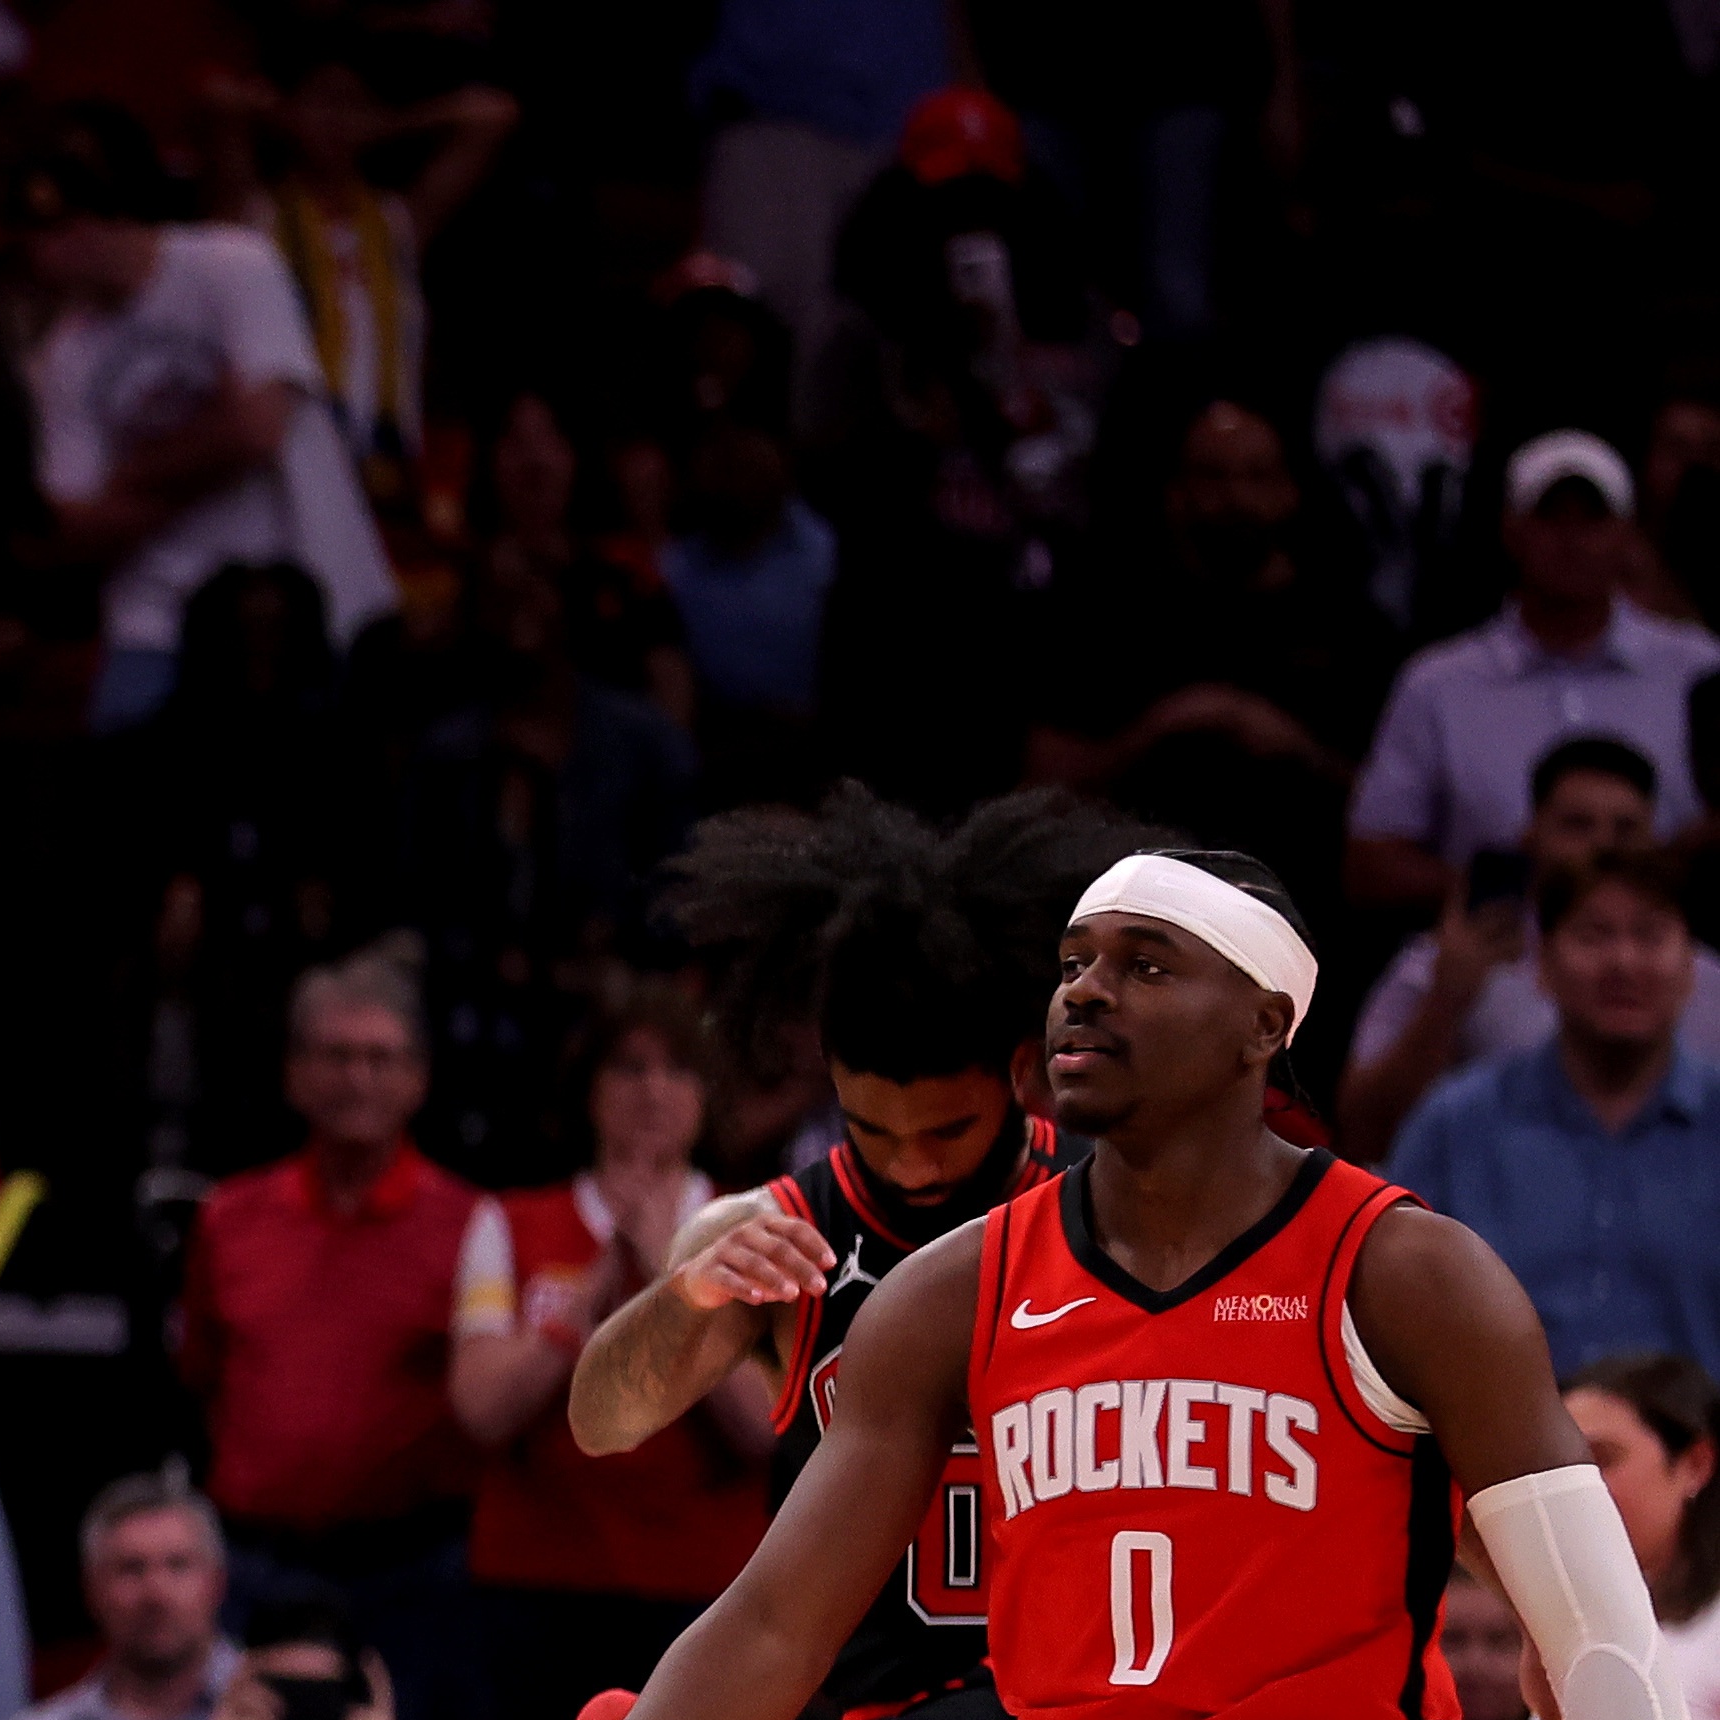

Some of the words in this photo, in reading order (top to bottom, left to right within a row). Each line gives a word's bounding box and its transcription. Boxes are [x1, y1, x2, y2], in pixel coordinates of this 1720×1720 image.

[1213, 1304, 1308, 1322] HERMANN
[1215, 1293, 1309, 1311] MEMORIAL
[991, 1378, 1319, 1521] ROCKETS
[1109, 1529, 1174, 1686] 0
